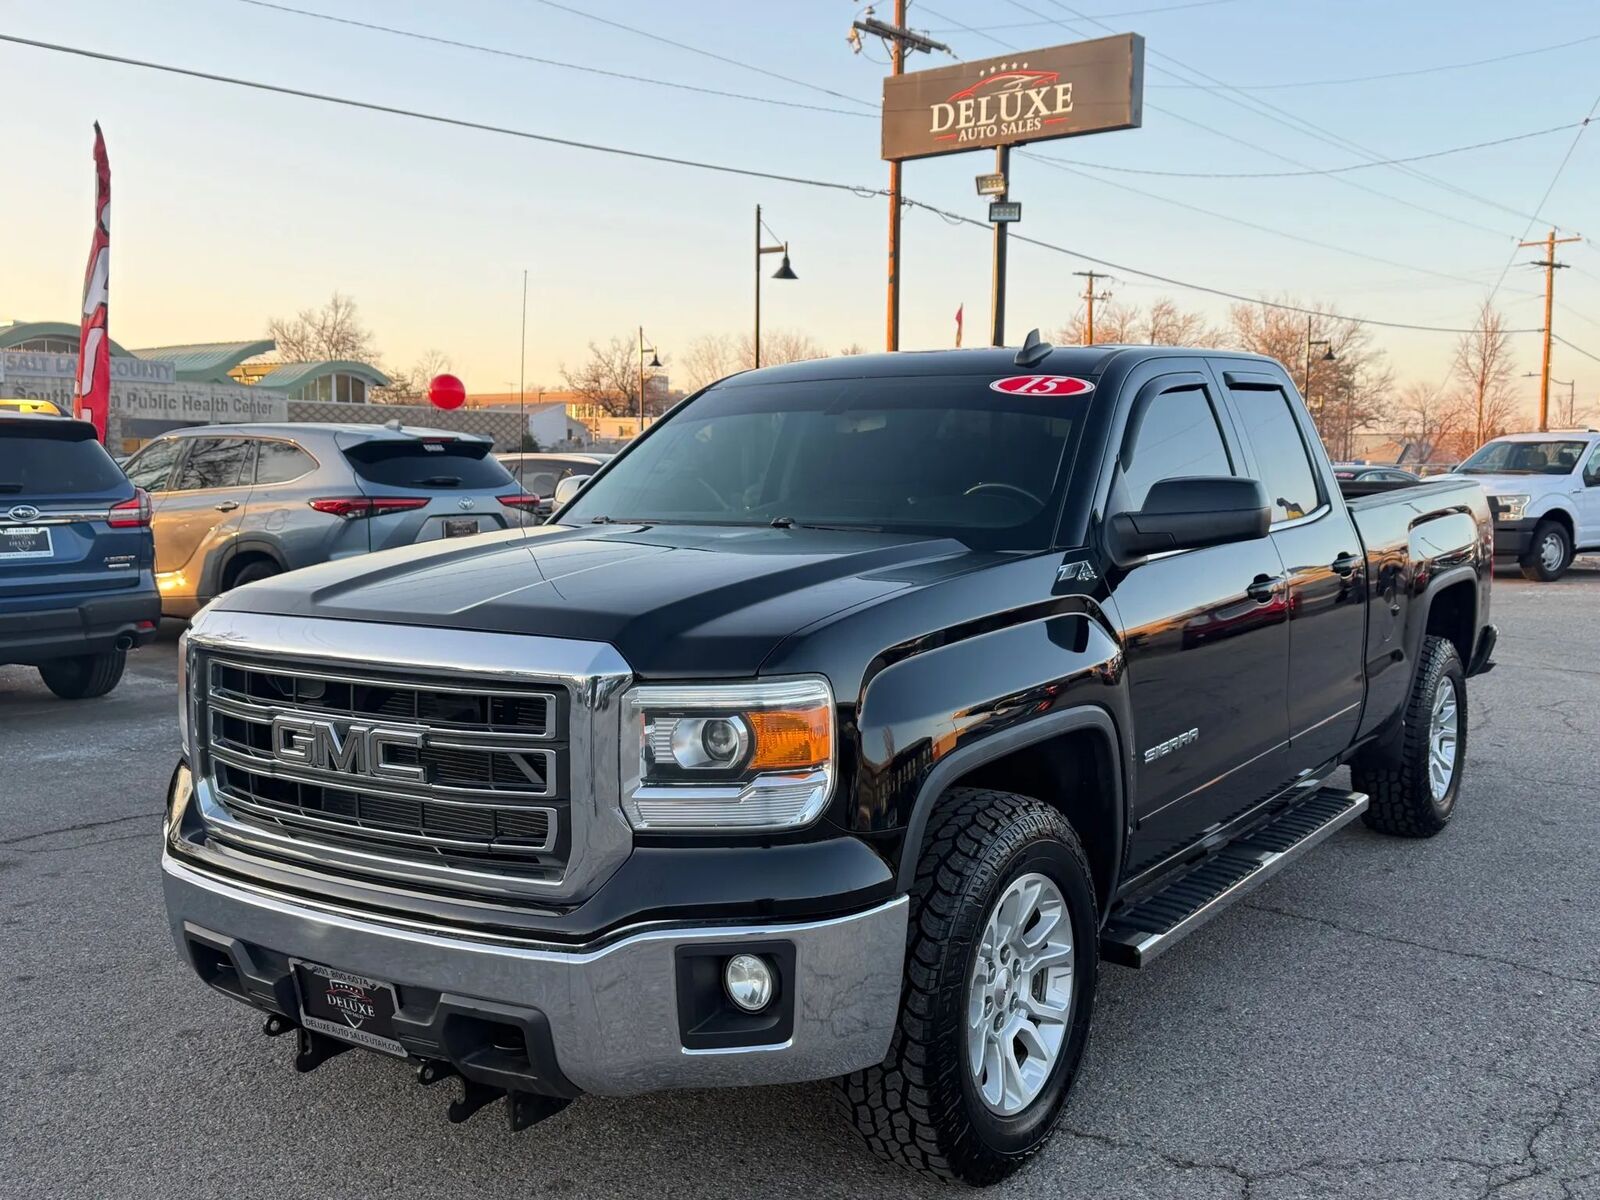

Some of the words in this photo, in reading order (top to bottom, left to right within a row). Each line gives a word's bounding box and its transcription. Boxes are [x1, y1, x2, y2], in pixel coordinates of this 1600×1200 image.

[929, 82, 1073, 132] DELUXE
[958, 125, 997, 142] AUTO
[1001, 117, 1041, 135] SALES
[6, 355, 49, 372] SALT
[1012, 377, 1068, 393] 15
[127, 391, 177, 411] Public
[182, 394, 229, 413] Health
[233, 400, 272, 416] Center
[272, 715, 426, 782] GMC
[1144, 727, 1199, 764] SIERRA
[327, 993, 375, 1017] DELUXE
[305, 1018, 330, 1032] DELUXE
[332, 1026, 349, 1037] AUTO
